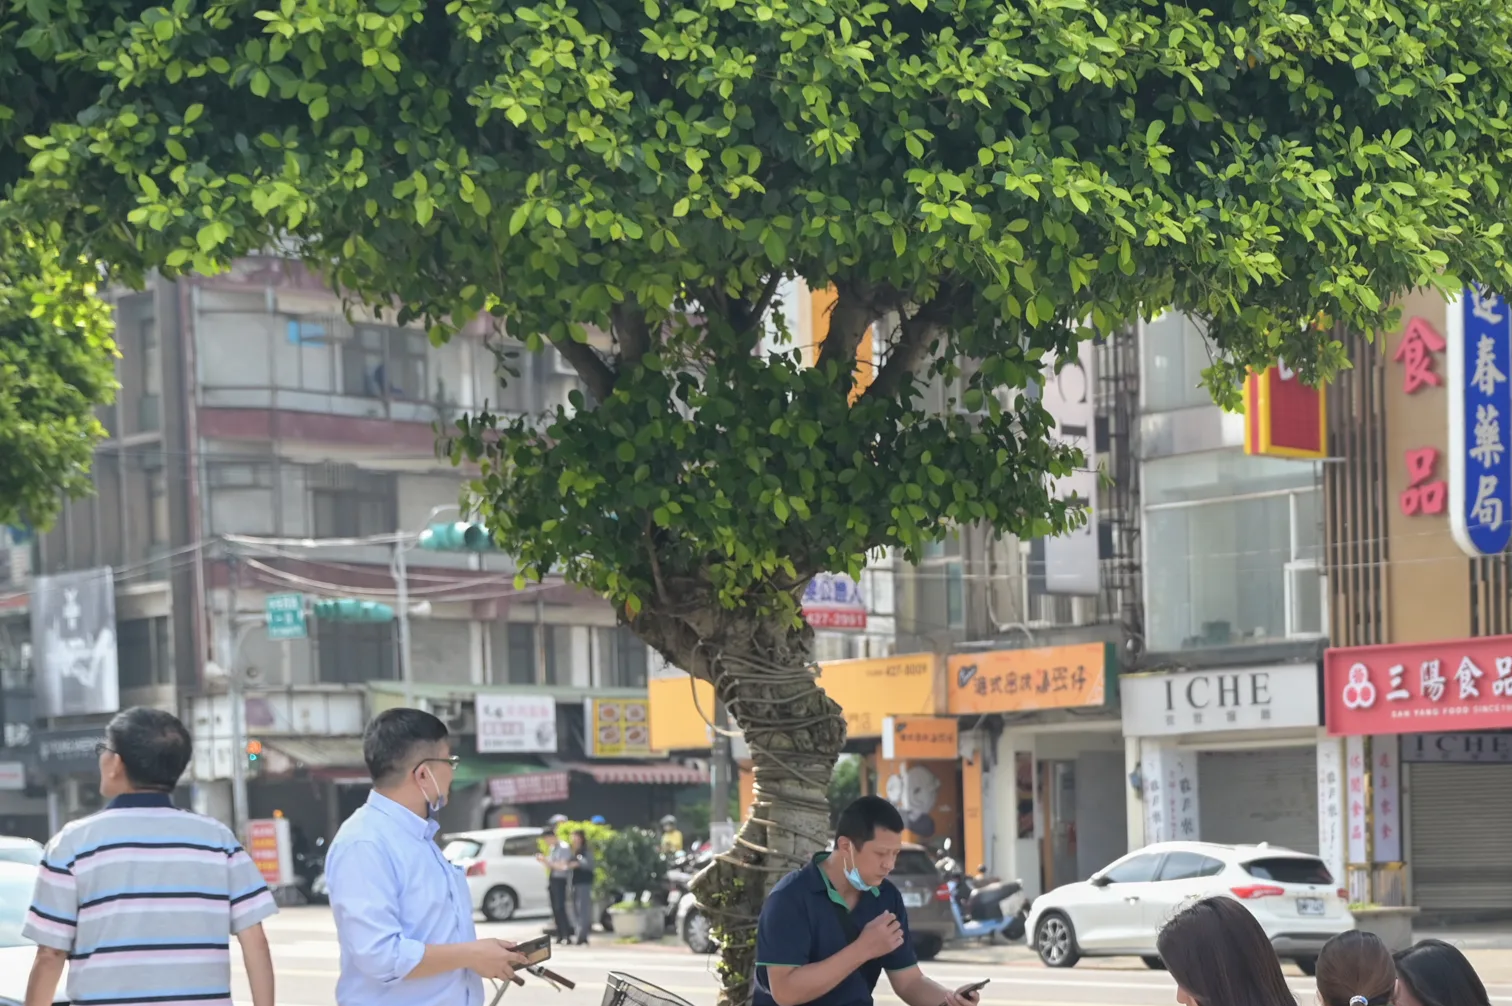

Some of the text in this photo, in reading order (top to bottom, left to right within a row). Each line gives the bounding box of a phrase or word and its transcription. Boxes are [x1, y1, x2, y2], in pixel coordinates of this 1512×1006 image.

[1396, 316, 1447, 517] 食品
[1164, 672, 1273, 711] ICHE
[1442, 706, 1470, 716] FOOD
